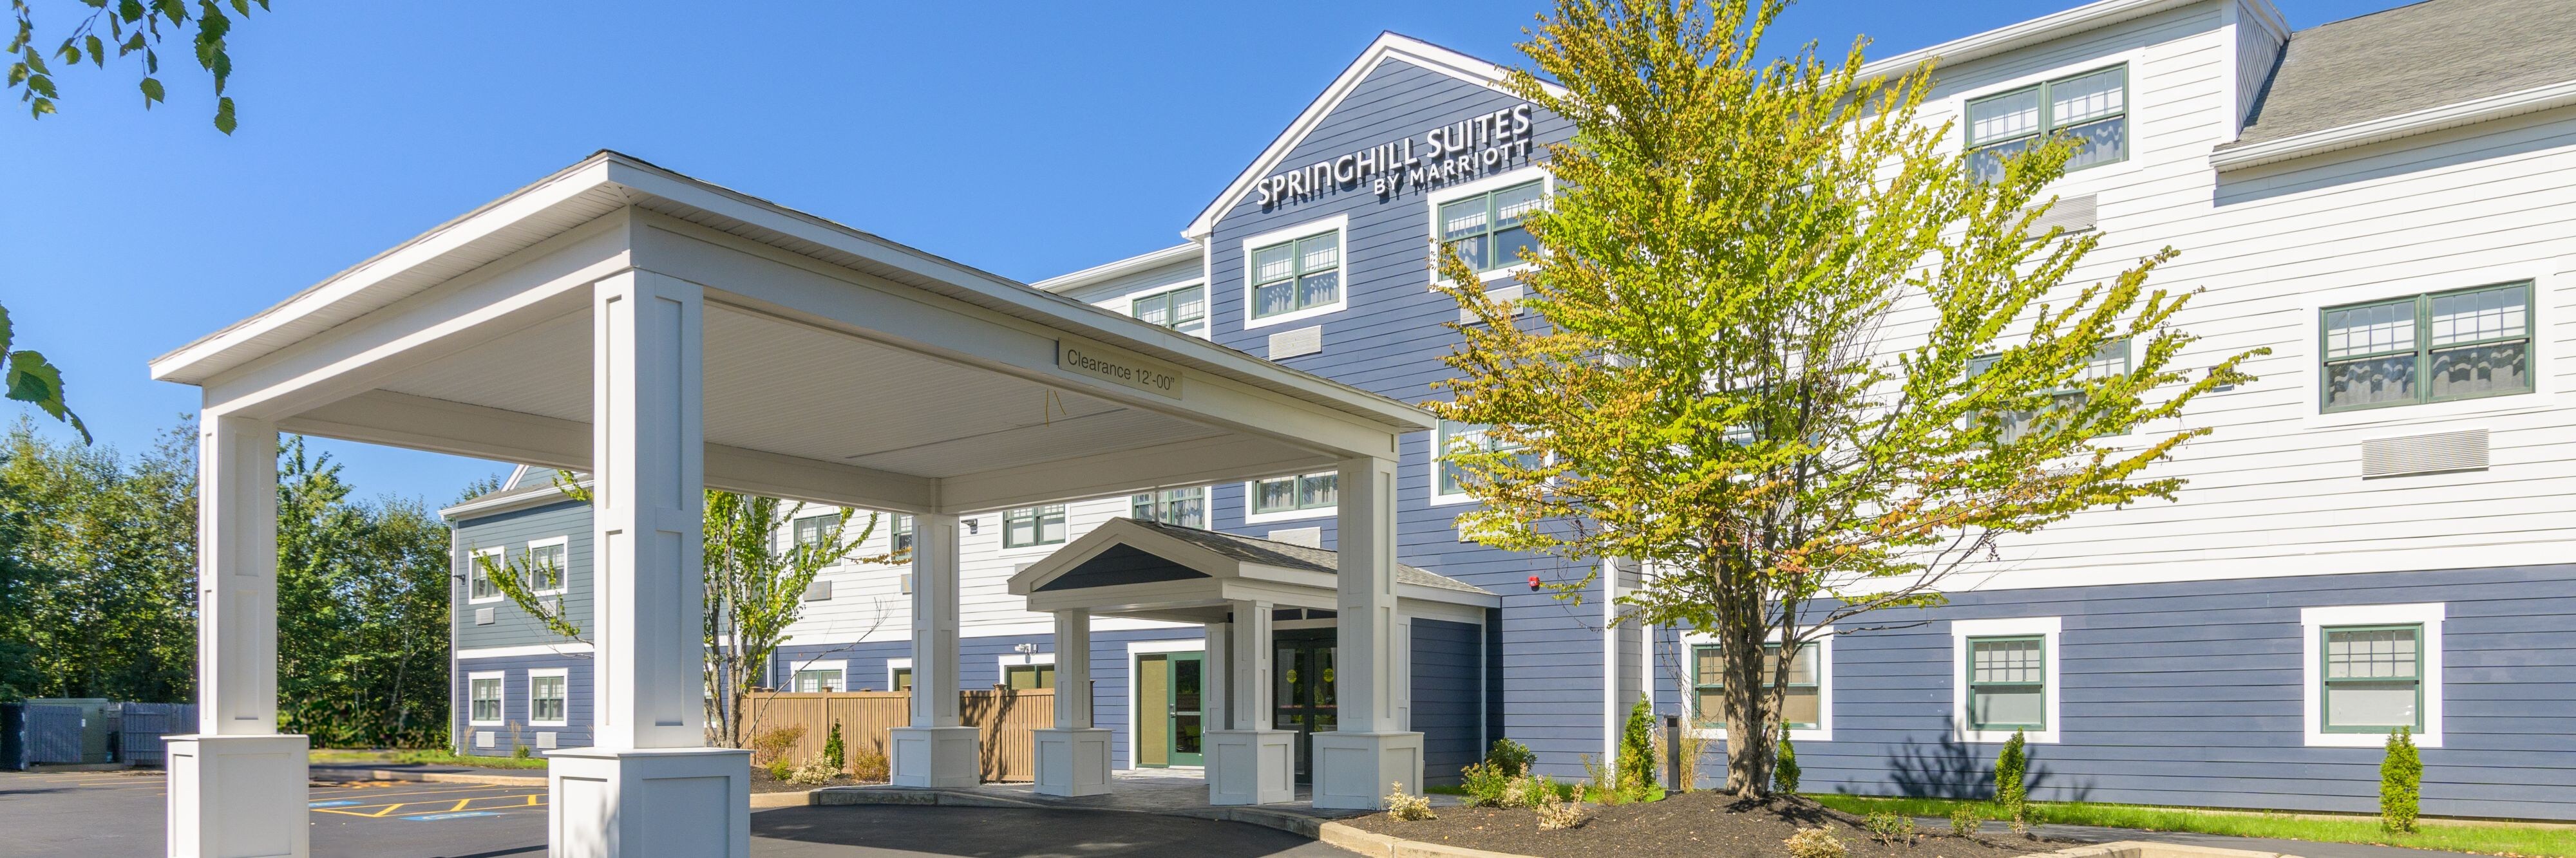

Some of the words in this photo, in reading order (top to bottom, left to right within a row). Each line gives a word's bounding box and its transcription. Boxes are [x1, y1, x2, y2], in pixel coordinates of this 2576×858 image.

[1257, 137, 1417, 205] SPRINGHILL
[1426, 104, 1530, 158] SUITES
[1374, 173, 1399, 196] BY
[1410, 138, 1530, 186] MARRIOTT
[1068, 350, 1131, 380] Clearance
